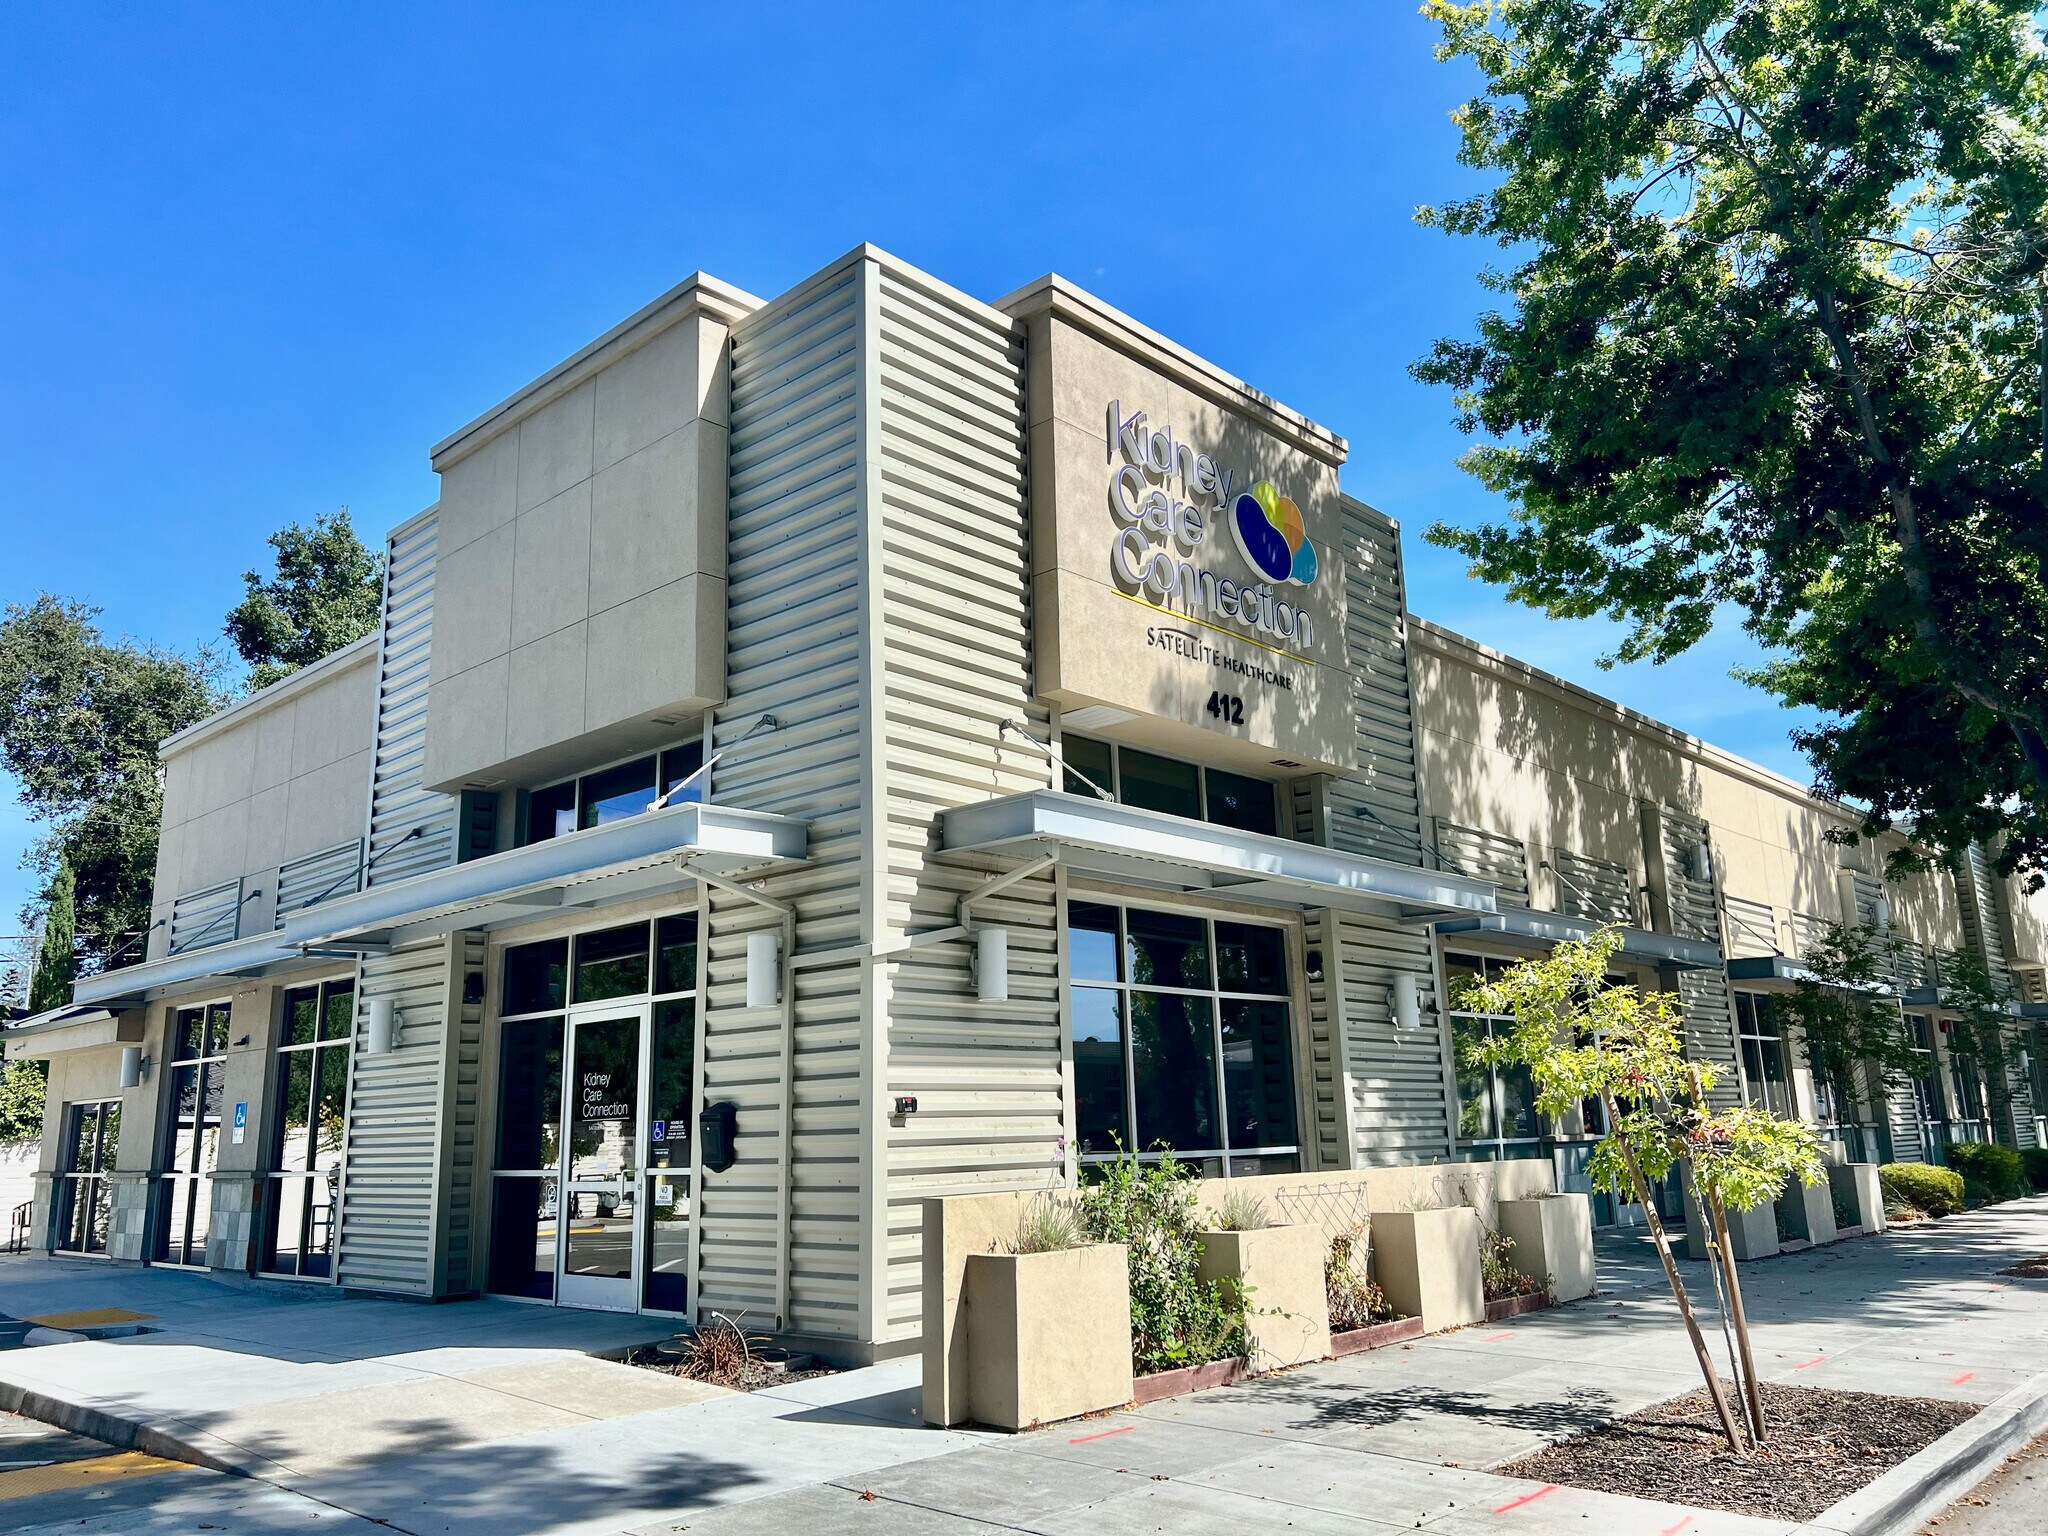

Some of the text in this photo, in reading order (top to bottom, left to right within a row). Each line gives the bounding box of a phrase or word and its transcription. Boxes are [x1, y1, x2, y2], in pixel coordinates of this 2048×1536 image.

[1108, 398, 1235, 512] Kidney
[1111, 464, 1203, 546] Care
[1113, 526, 1313, 649] Connection
[1223, 656, 1293, 690] HEALTHCARE
[1206, 691, 1244, 725] 412
[583, 1072, 611, 1088] Kidney
[583, 1087, 603, 1102] Care
[582, 1101, 628, 1118] Connection
